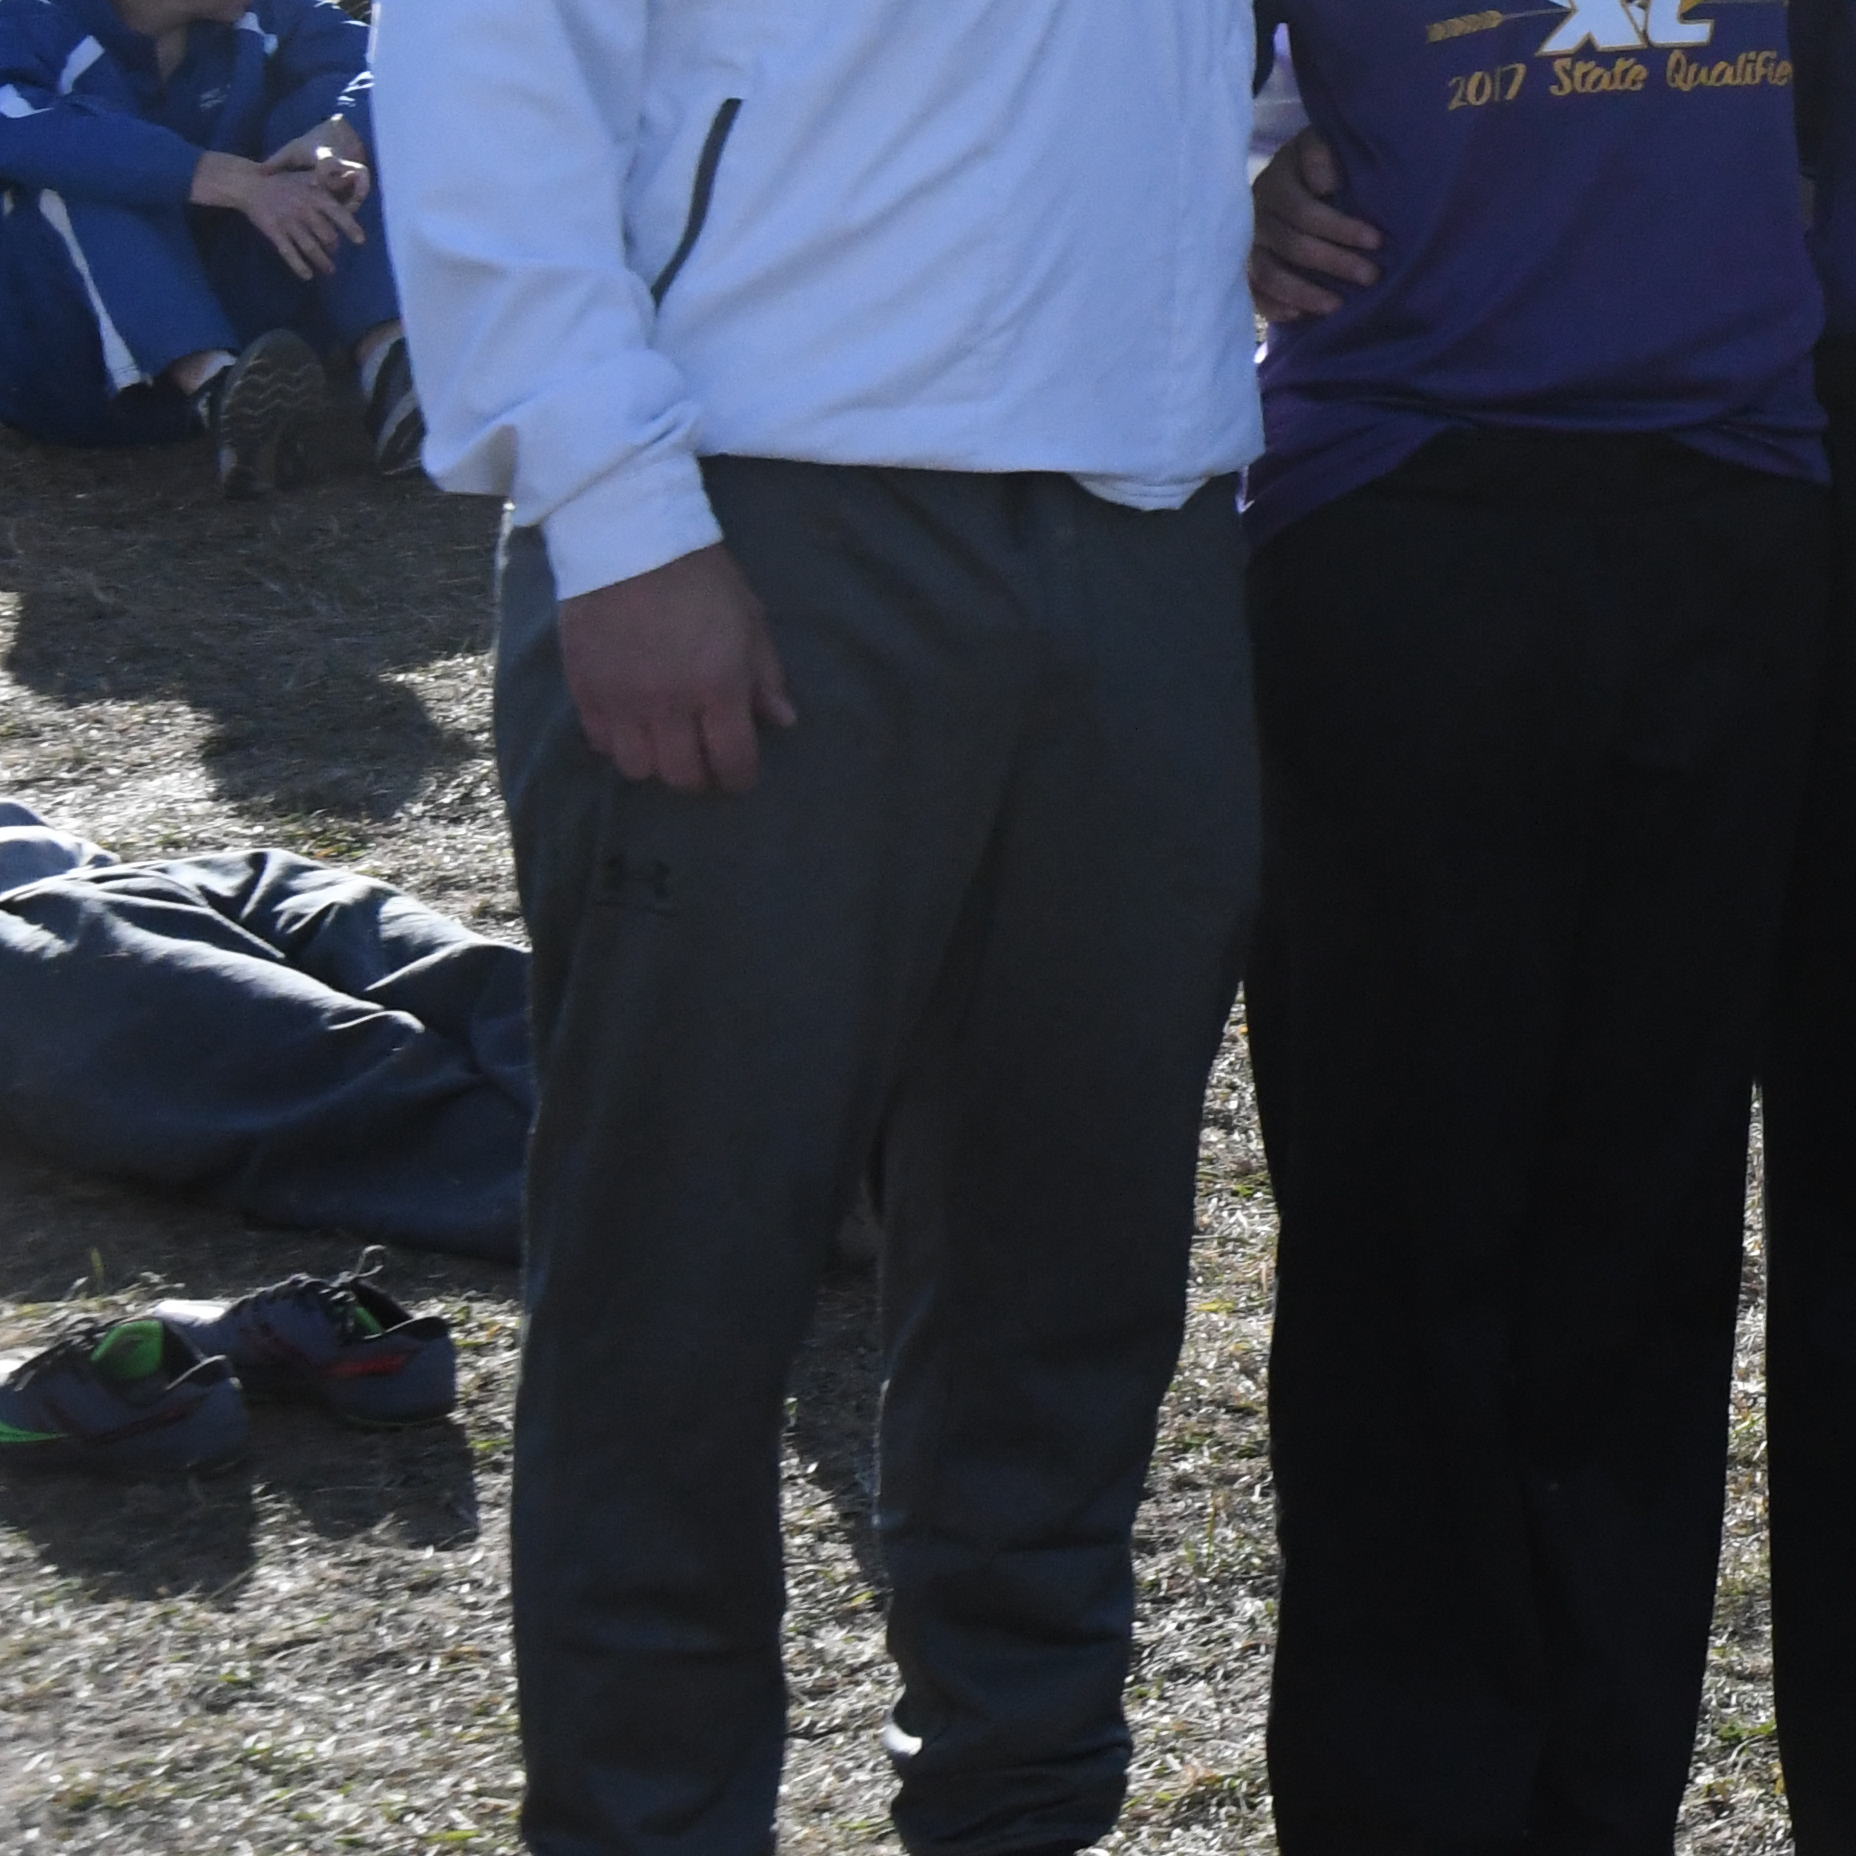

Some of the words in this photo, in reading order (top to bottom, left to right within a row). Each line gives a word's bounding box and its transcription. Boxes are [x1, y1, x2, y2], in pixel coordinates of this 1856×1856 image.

[1448, 63, 1526, 110] 2017
[1550, 56, 1648, 95] State
[1666, 49, 1793, 91] Qualifie
